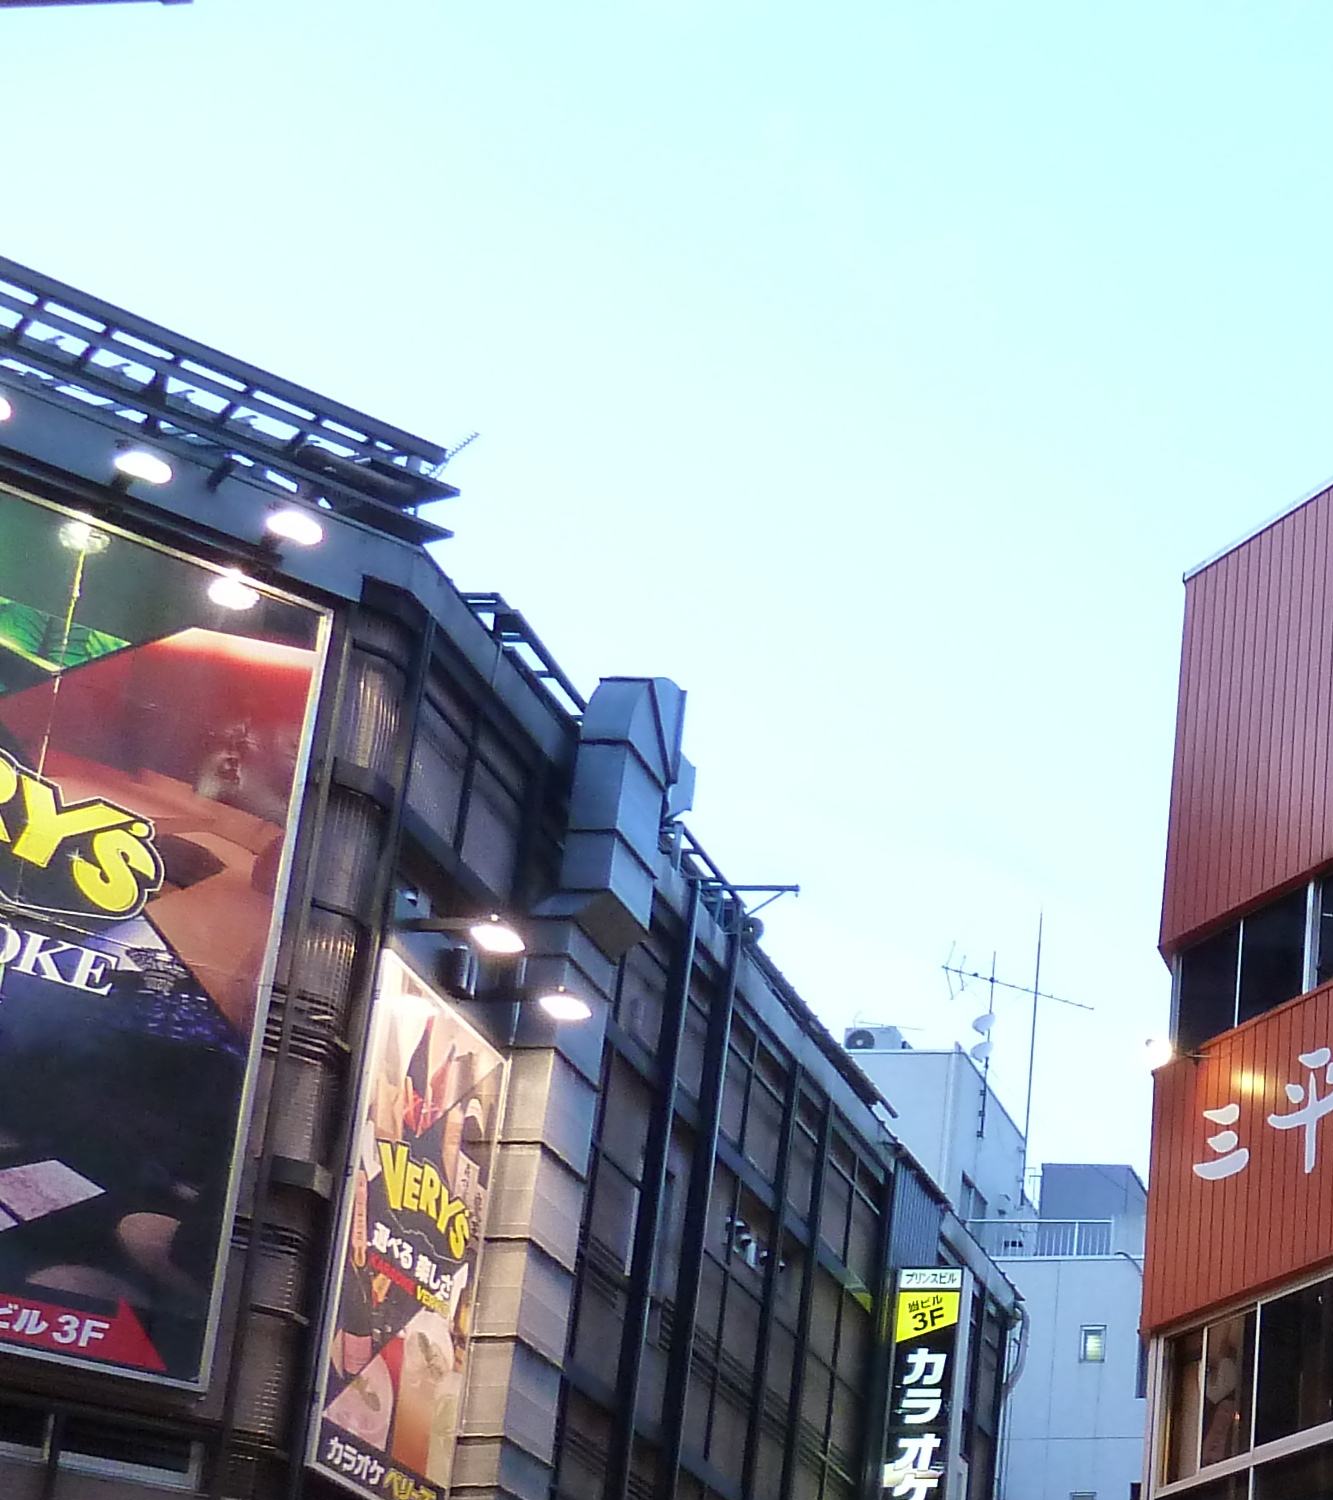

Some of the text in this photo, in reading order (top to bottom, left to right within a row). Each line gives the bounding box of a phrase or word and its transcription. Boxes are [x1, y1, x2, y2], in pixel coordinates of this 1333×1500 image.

[377, 1140, 471, 1260] VERY'S
[905, 1271, 958, 1285] プリンスビル
[908, 1294, 943, 1313] 当ビル
[911, 1306, 945, 1332] 3F
[326, 1436, 385, 1486] カラオケ
